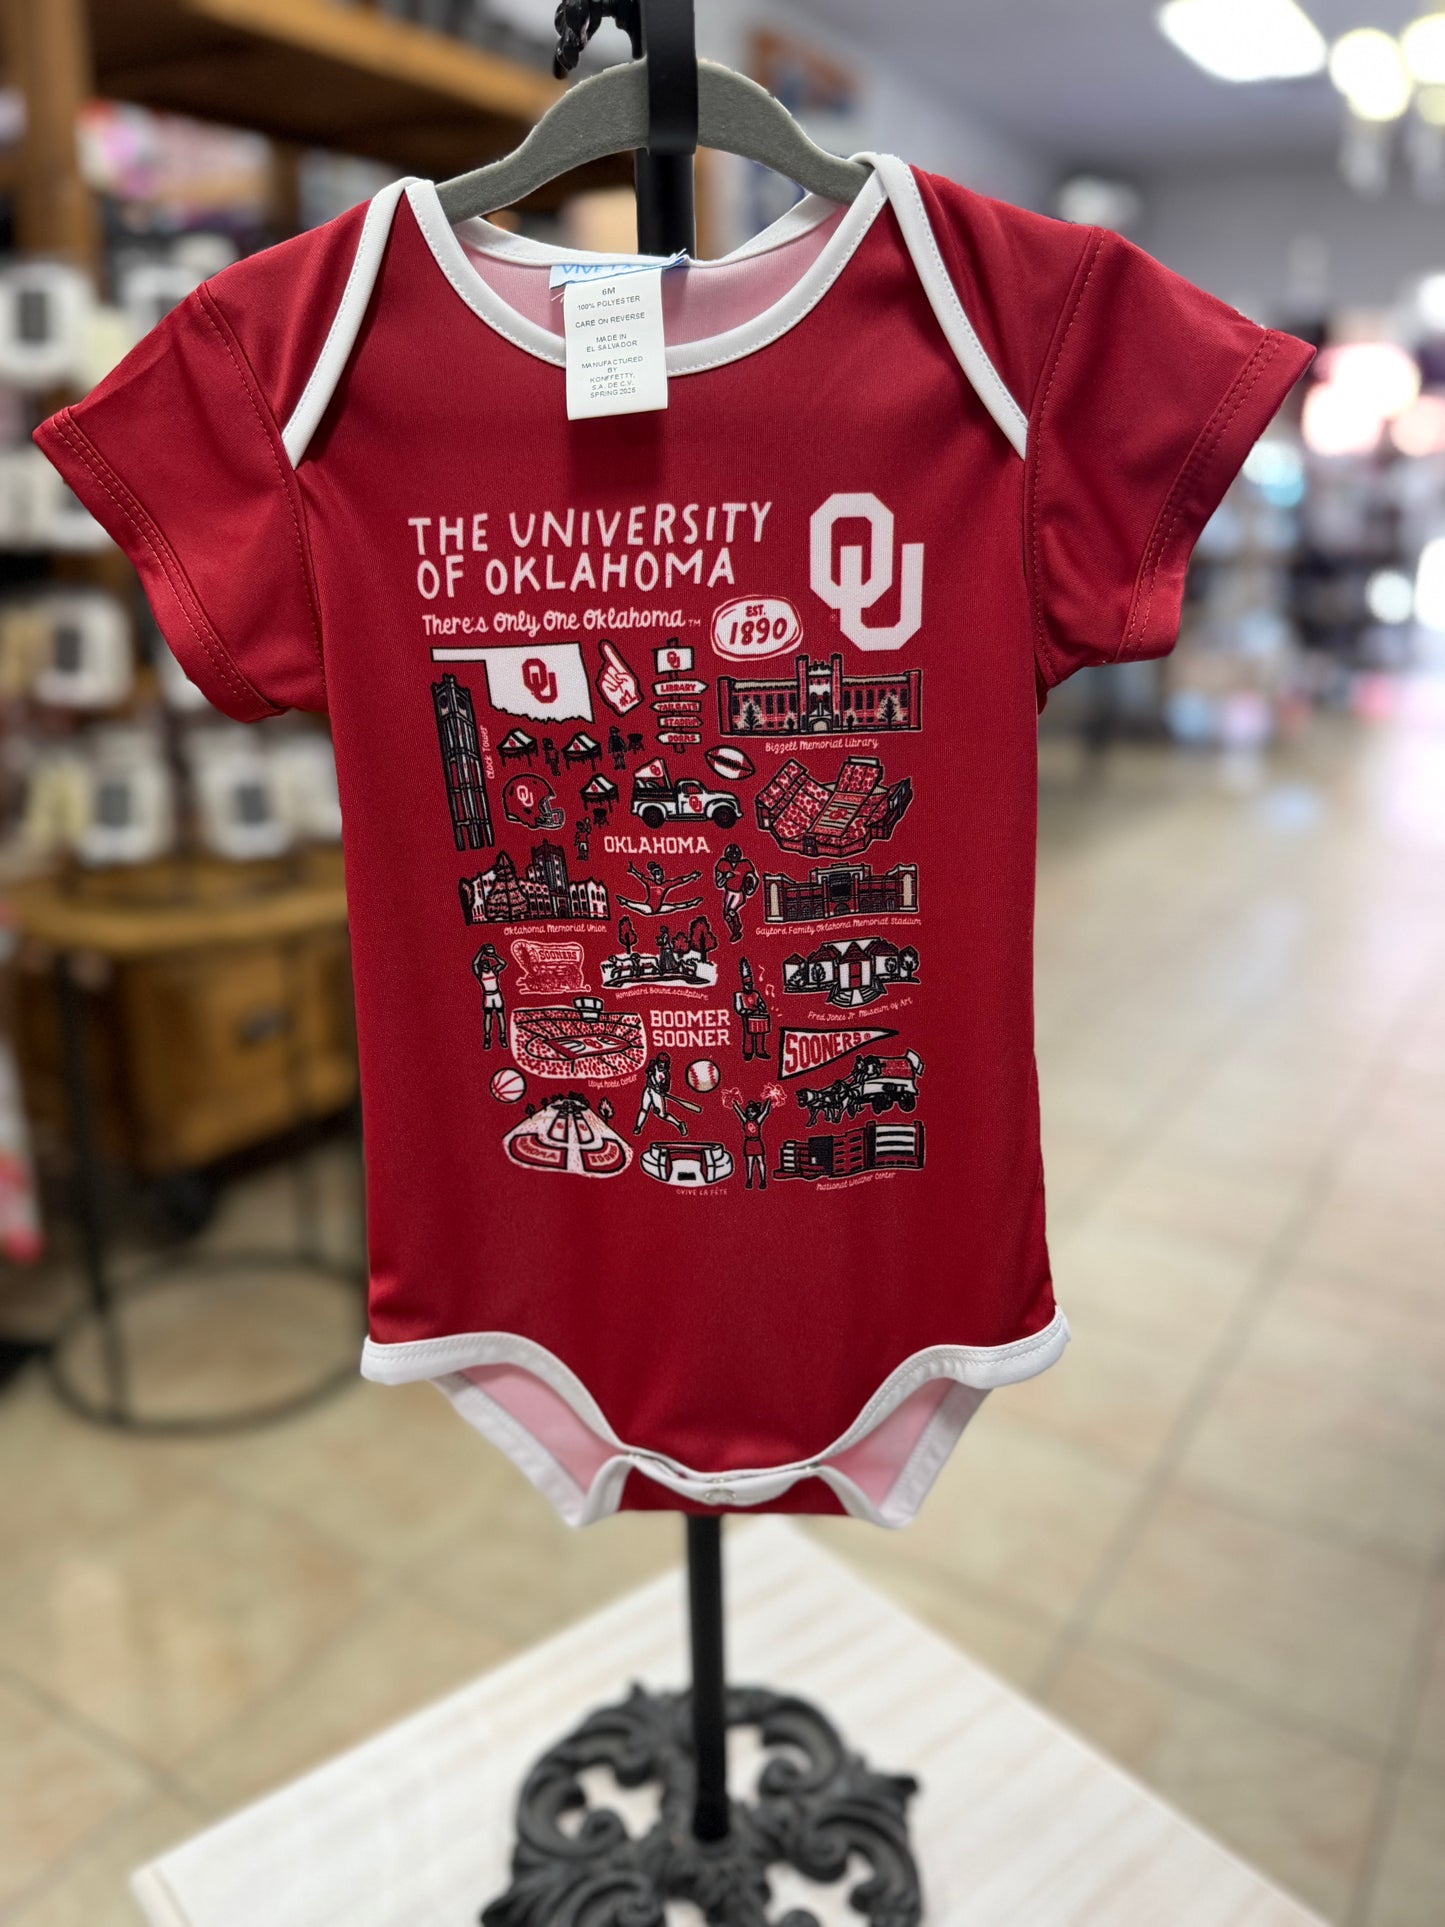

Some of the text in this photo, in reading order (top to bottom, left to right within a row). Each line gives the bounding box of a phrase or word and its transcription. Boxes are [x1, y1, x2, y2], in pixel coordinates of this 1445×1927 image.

[602, 287, 616, 295] 6M
[597, 295, 641, 307] POLYESTER
[575, 319, 596, 328] CARE
[610, 312, 646, 323] REVERSE
[596, 334, 618, 343] MADE
[598, 340, 638, 351] SALVADOR
[581, 355, 644, 369] MANUFACTURED
[590, 389, 618, 398] SPRING
[608, 381, 618, 389] DE
[407, 501, 772, 556] THE UNIVERSITY
[416, 547, 735, 600] OF OKLAHOMA
[810, 492, 925, 652] OU
[745, 604, 767, 617] EST.
[421, 614, 489, 636] There's
[493, 609, 540, 637] Only
[543, 609, 580, 631] One
[583, 606, 686, 631] Oklahoma
[728, 617, 788, 645] 1890
[666, 651, 681, 669] OU
[520, 657, 559, 704] OU
[660, 683, 697, 693] LIBRARY
[799, 739, 843, 751] Memorial
[844, 737, 879, 749] Library
[516, 785, 534, 807] OU
[603, 835, 711, 855] OKLAHOMA
[503, 923, 607, 936] Oklahoma Memorial Union
[755, 916, 922, 937] Gaylord Family Oklahoma Memorial Stadium
[538, 950, 578, 961] SOONERS
[807, 1011, 826, 1022] Fred
[858, 1004, 889, 1018] Museum
[890, 1002, 899, 1010] of
[900, 997, 913, 1008] Art
[649, 1009, 731, 1028] BOOMER
[652, 1029, 731, 1048] SOONER
[784, 1031, 862, 1074] SOONERS
[874, 1172, 897, 1180] Center
